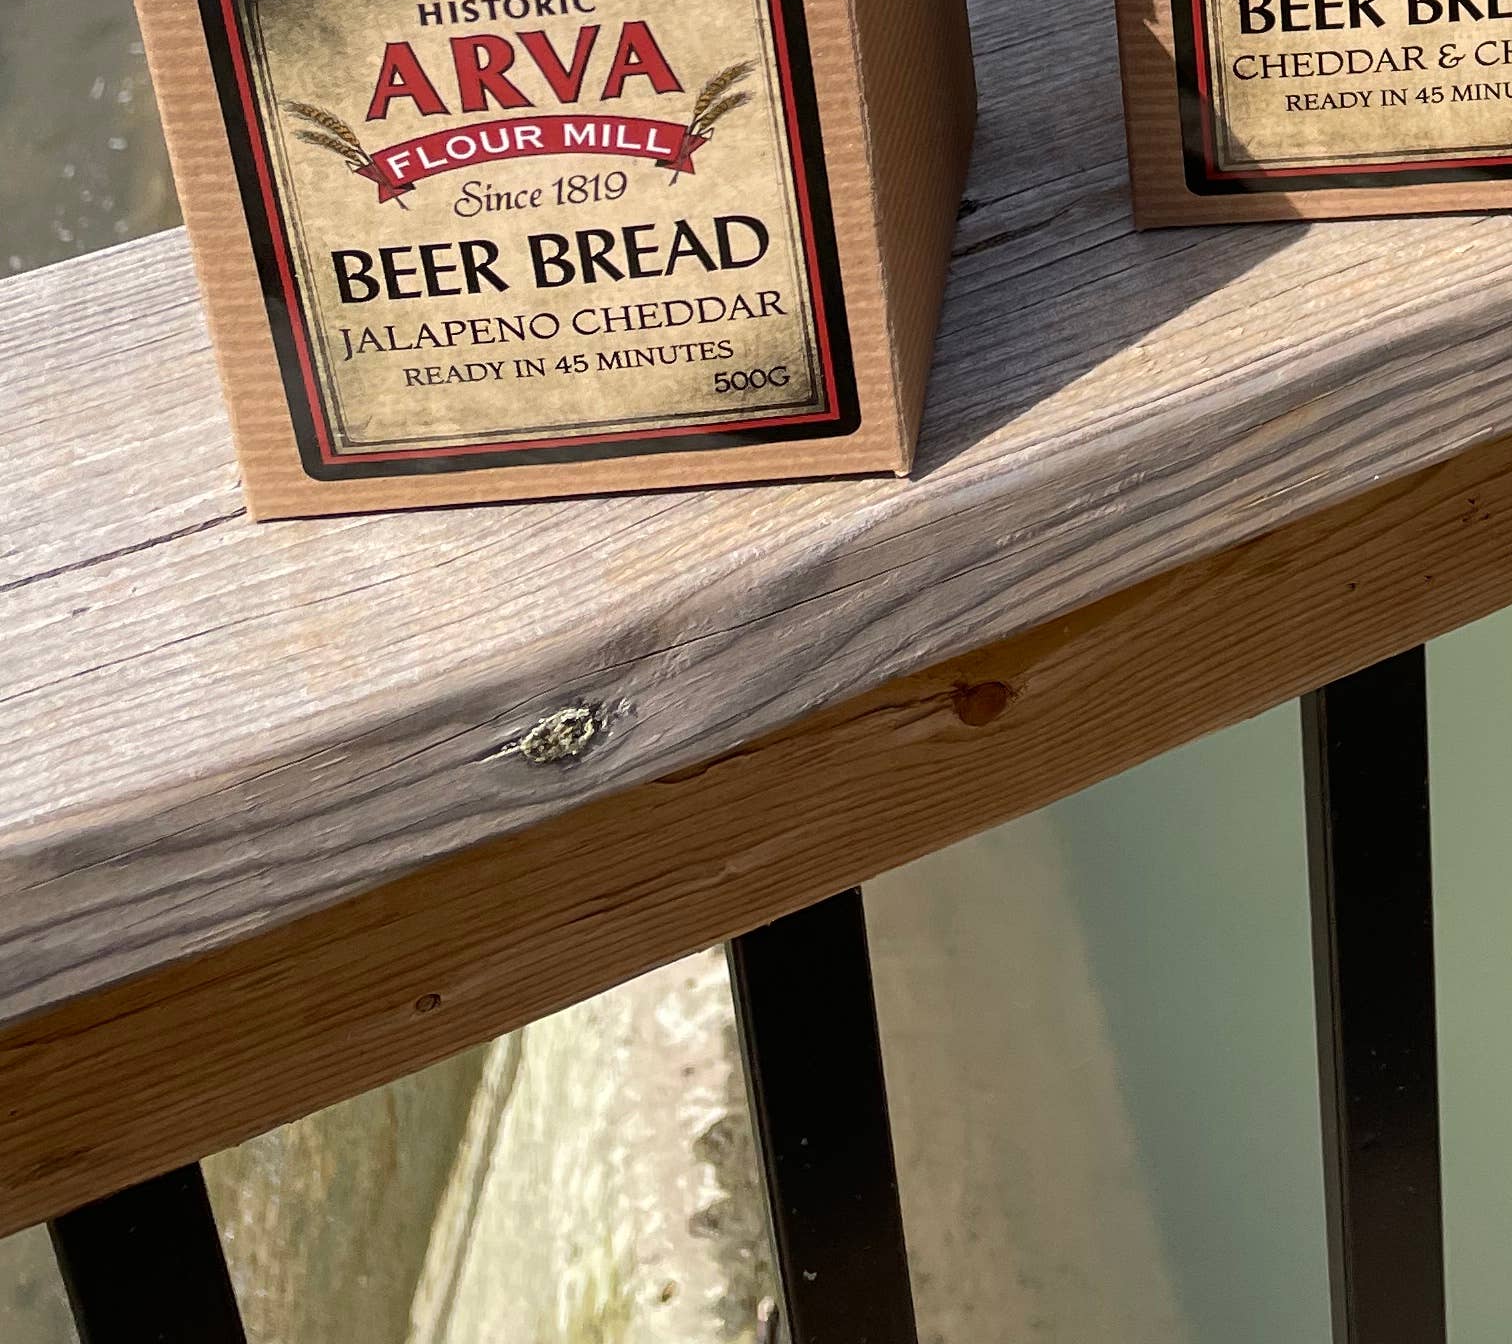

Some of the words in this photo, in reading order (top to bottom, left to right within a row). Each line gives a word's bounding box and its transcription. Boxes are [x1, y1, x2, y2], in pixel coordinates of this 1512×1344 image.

[365, 20, 685, 123] ARVA
[1231, 44, 1427, 81] CHEDDAR
[1437, 43, 1467, 69] &
[1284, 91, 1377, 113] READY
[1380, 88, 1410, 107] IN
[1414, 86, 1445, 105] 45
[386, 124, 543, 181] FLOUR
[562, 123, 673, 156] MILL
[452, 178, 543, 218] Since
[553, 170, 629, 207] 1819
[331, 238, 508, 306] BEER
[528, 212, 770, 291] BREAD
[338, 311, 561, 362] JALAPENO
[571, 289, 788, 336] CHEDDAR
[401, 360, 508, 389] READY
[512, 357, 547, 379] IN
[552, 353, 590, 375] 45
[595, 338, 735, 372] MINUTES
[713, 365, 792, 395] 500G
